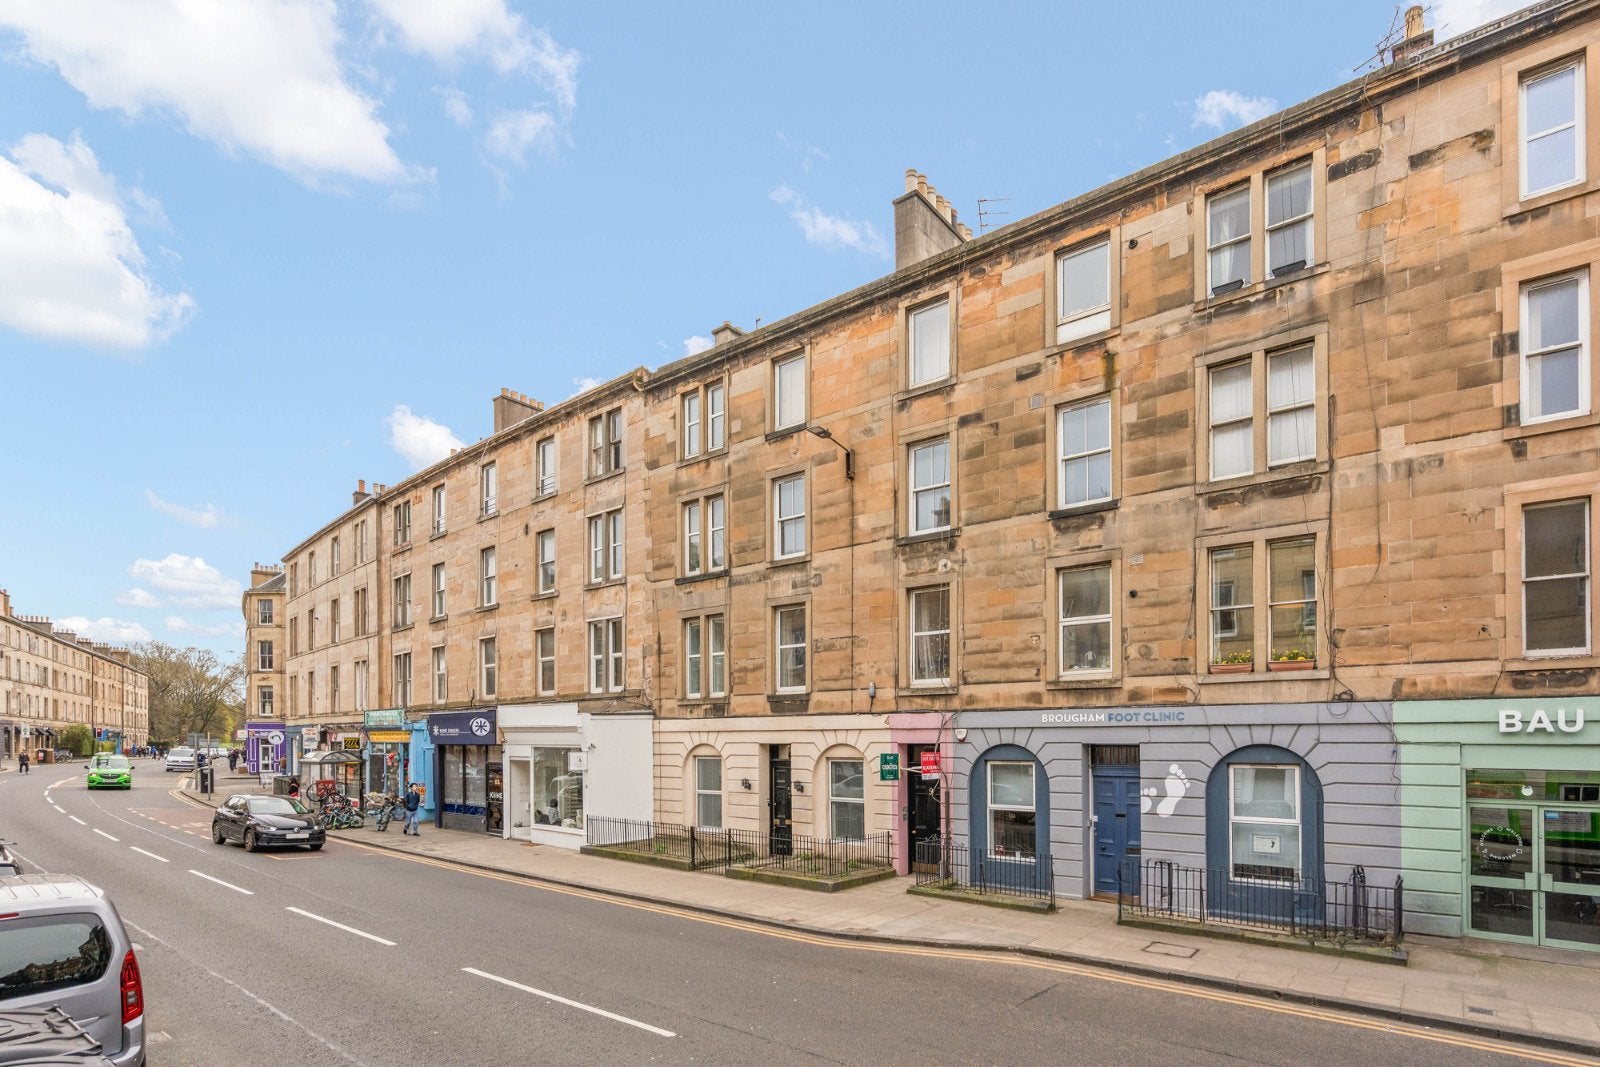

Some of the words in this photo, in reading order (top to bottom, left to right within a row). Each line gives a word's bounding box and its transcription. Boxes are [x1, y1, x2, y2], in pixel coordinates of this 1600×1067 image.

[1041, 713, 1105, 723] BROUGHAM
[1108, 712, 1141, 722] FOOT
[1143, 711, 1185, 722] CLINIC
[1499, 709, 1584, 733] BAU
